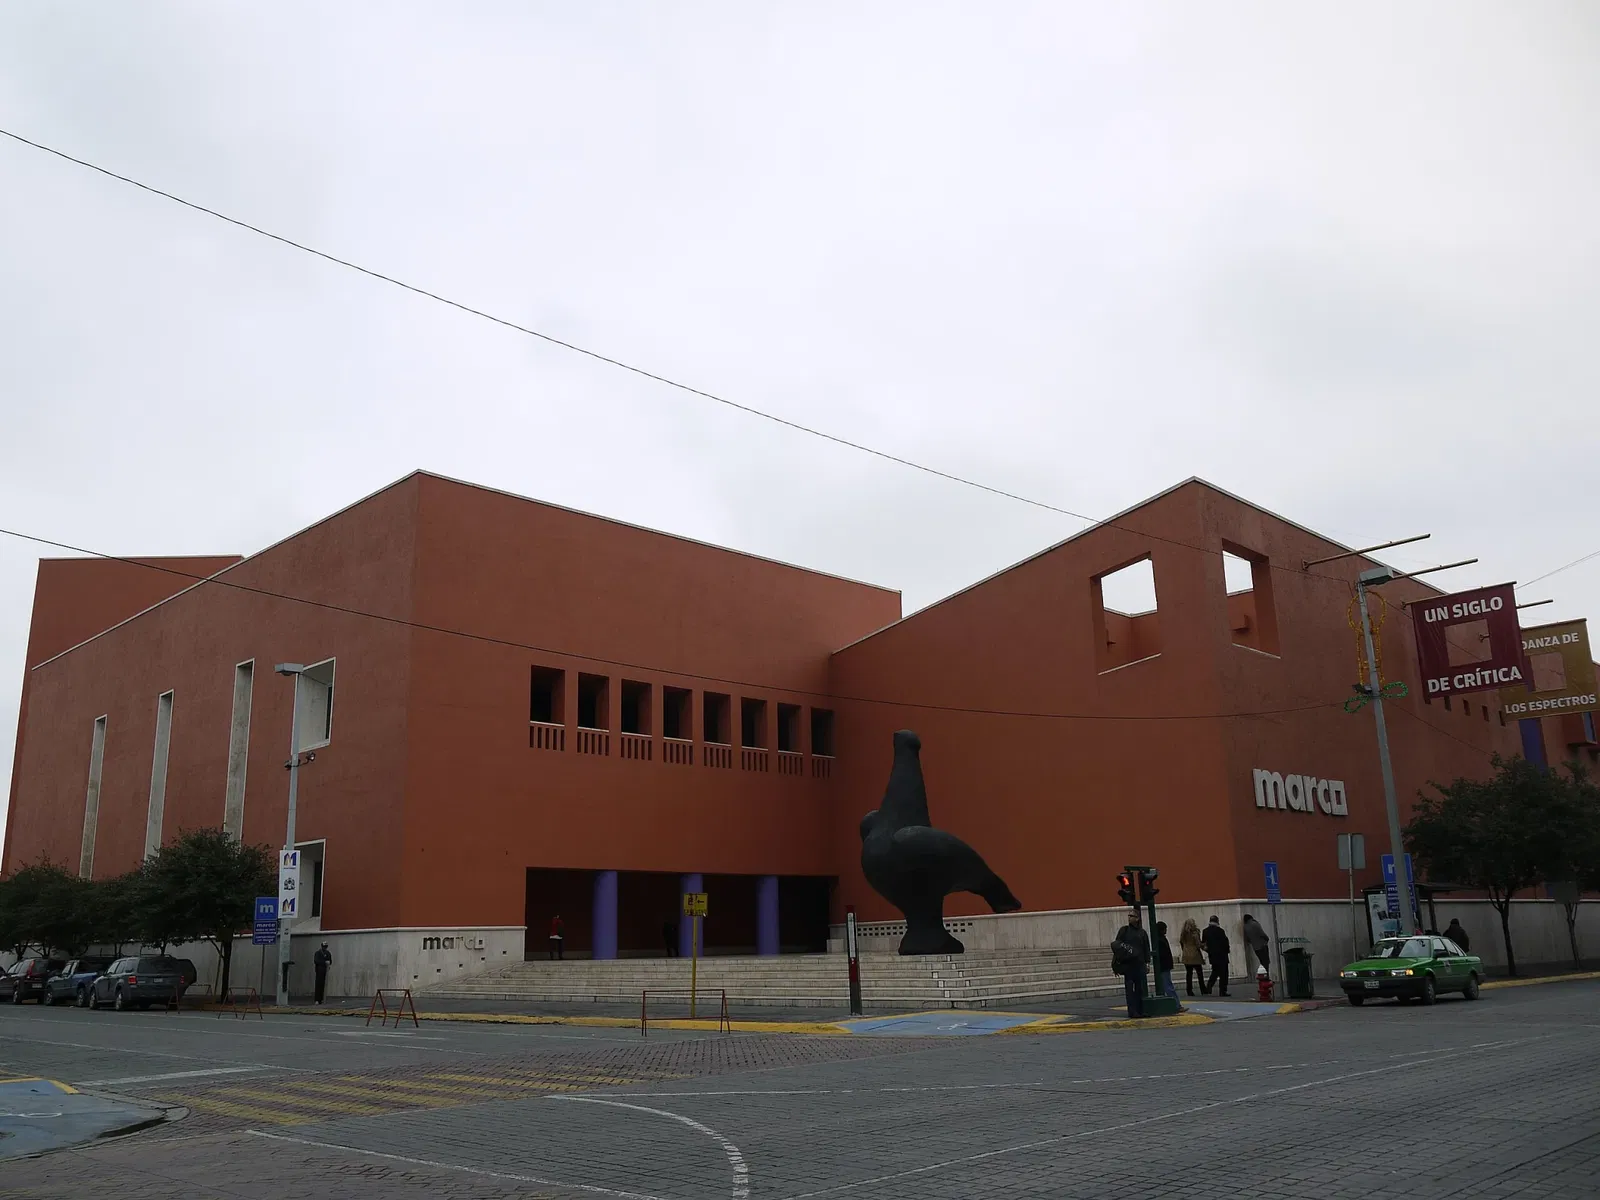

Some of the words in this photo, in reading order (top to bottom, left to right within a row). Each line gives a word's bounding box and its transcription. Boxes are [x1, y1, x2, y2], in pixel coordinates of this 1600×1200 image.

[1424, 607, 1449, 623] UN
[1452, 596, 1504, 619] SIGLO
[1563, 632, 1580, 645] DE
[1427, 676, 1451, 693] DE
[1453, 665, 1522, 689] CRÍTICA
[1505, 701, 1527, 715] LOS
[1529, 694, 1597, 712] ESPECTROS
[260, 904, 274, 913] m
